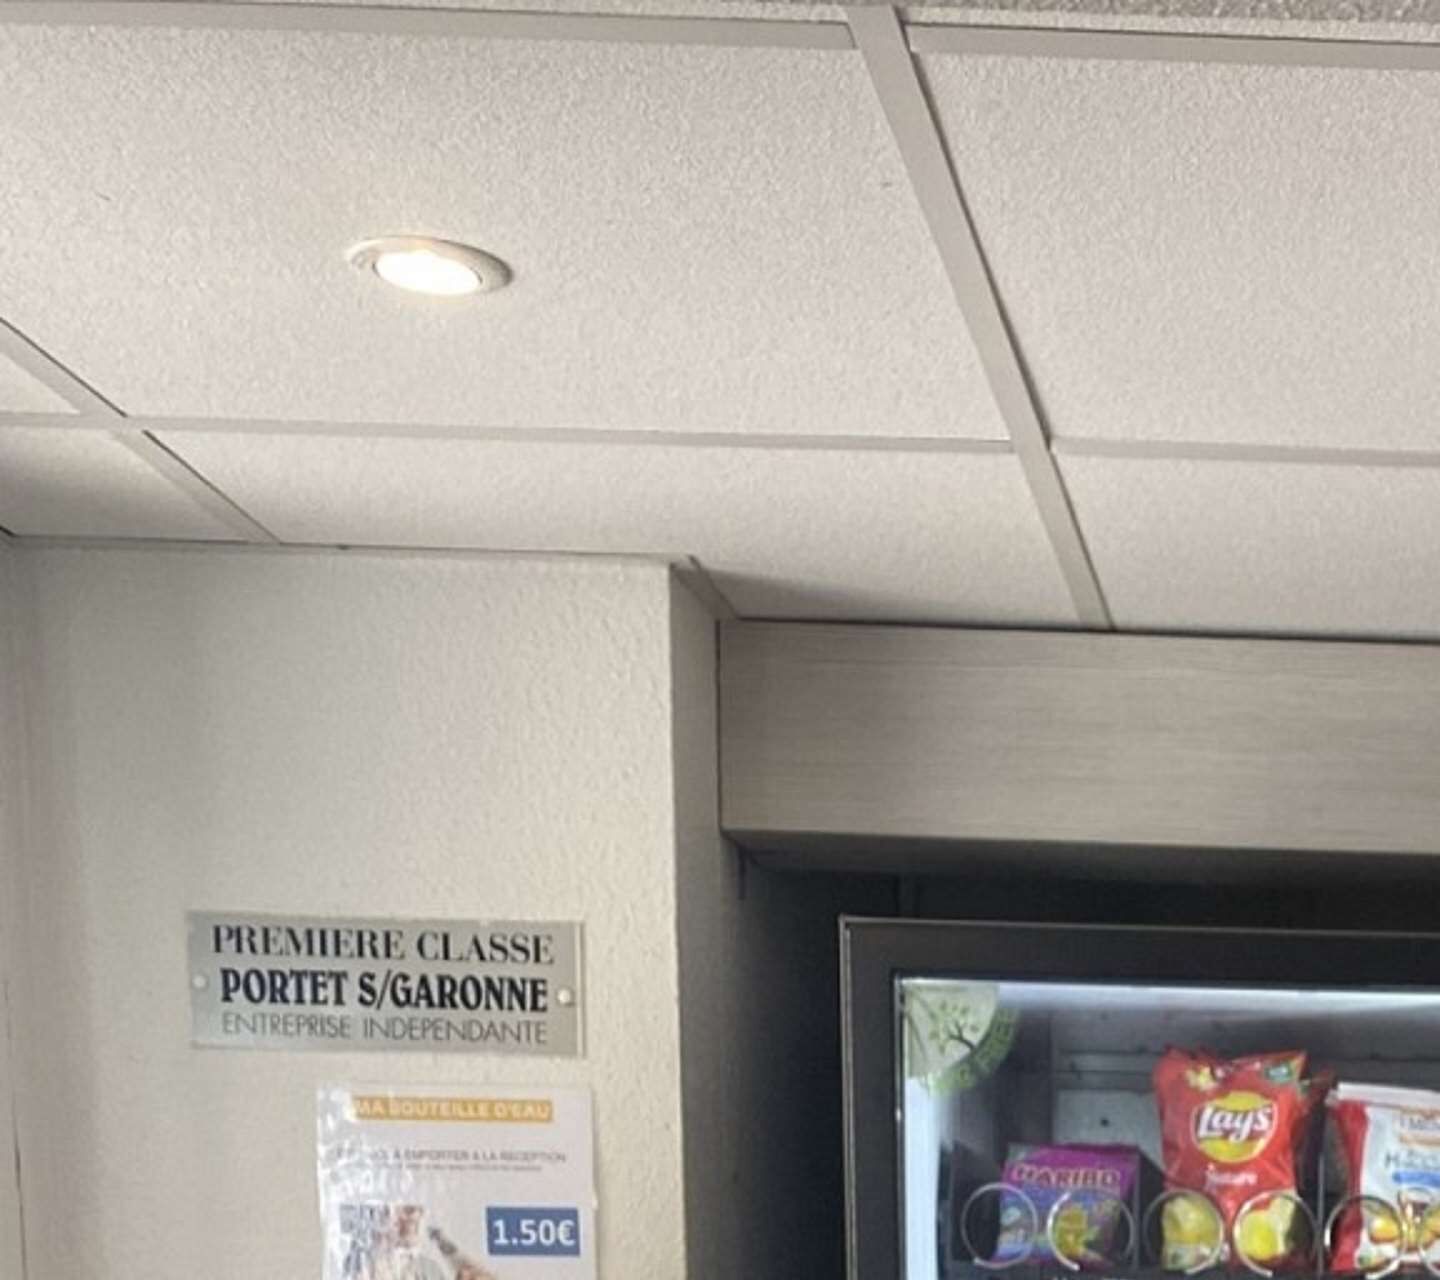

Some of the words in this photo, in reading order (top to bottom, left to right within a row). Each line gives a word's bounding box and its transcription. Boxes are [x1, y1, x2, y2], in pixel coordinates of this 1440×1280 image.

[211, 924, 405, 960] PREMIERE
[416, 931, 555, 965] CLASSE
[219, 968, 349, 1007] PORTET
[357, 969, 548, 1012] S/GARONNE
[222, 1012, 351, 1039] ENTREPRISE
[364, 1018, 547, 1044] INDEPENDANTE
[494, 1218, 577, 1246] 1.50€
